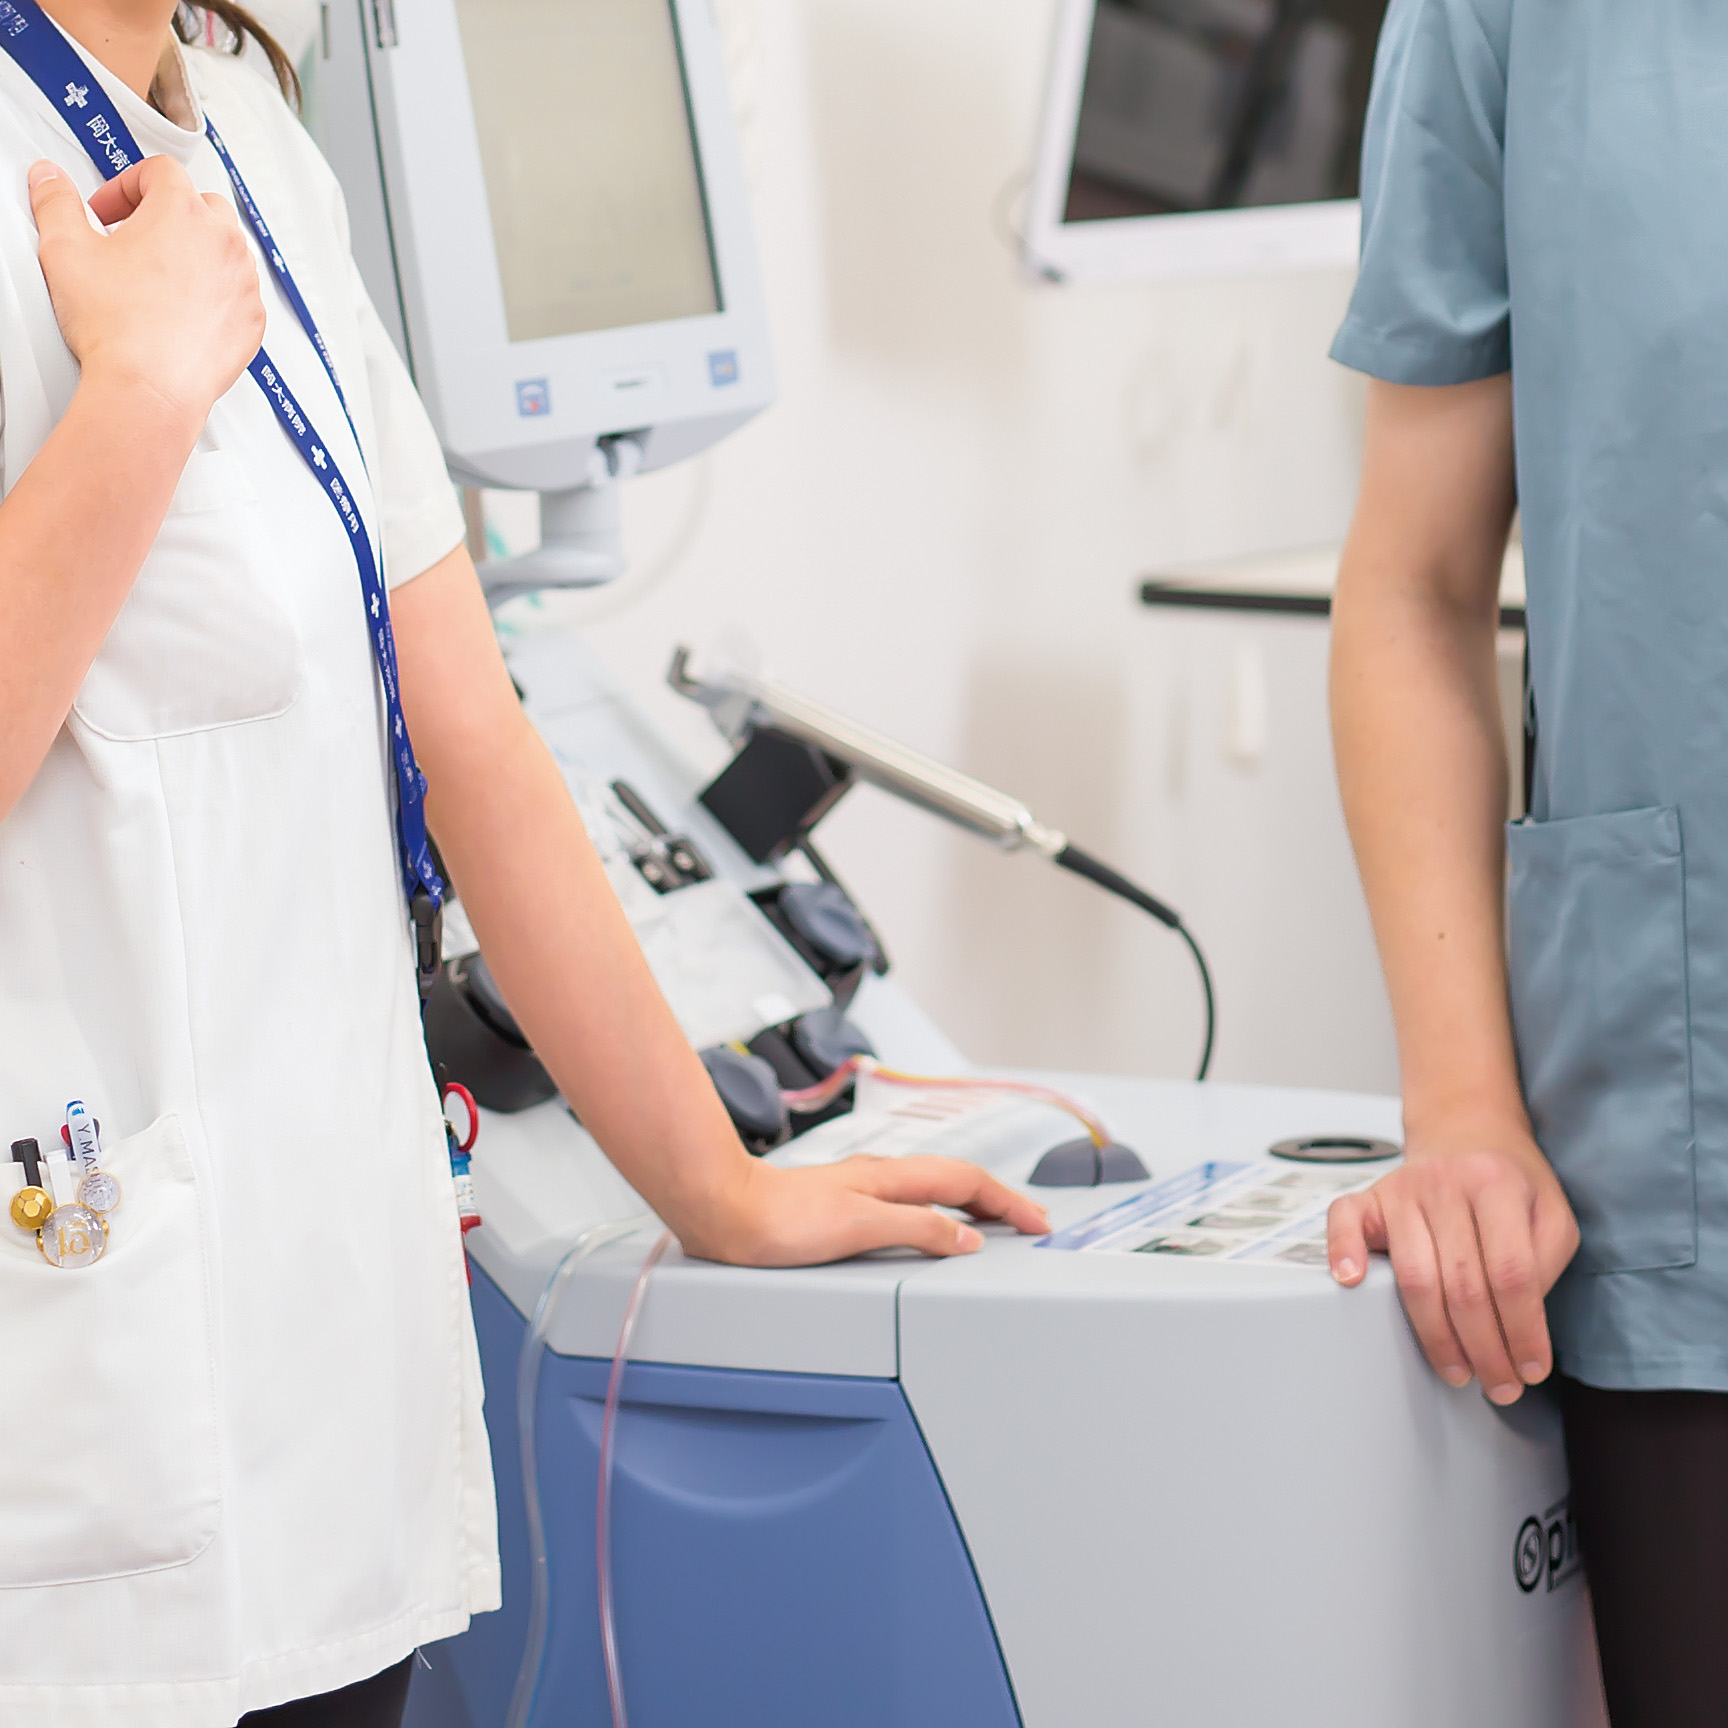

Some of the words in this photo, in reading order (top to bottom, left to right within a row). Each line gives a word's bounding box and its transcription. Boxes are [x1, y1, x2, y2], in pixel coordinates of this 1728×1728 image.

[86, 114, 133, 172] 岡大病
[261, 365, 306, 436] 岡大病院
